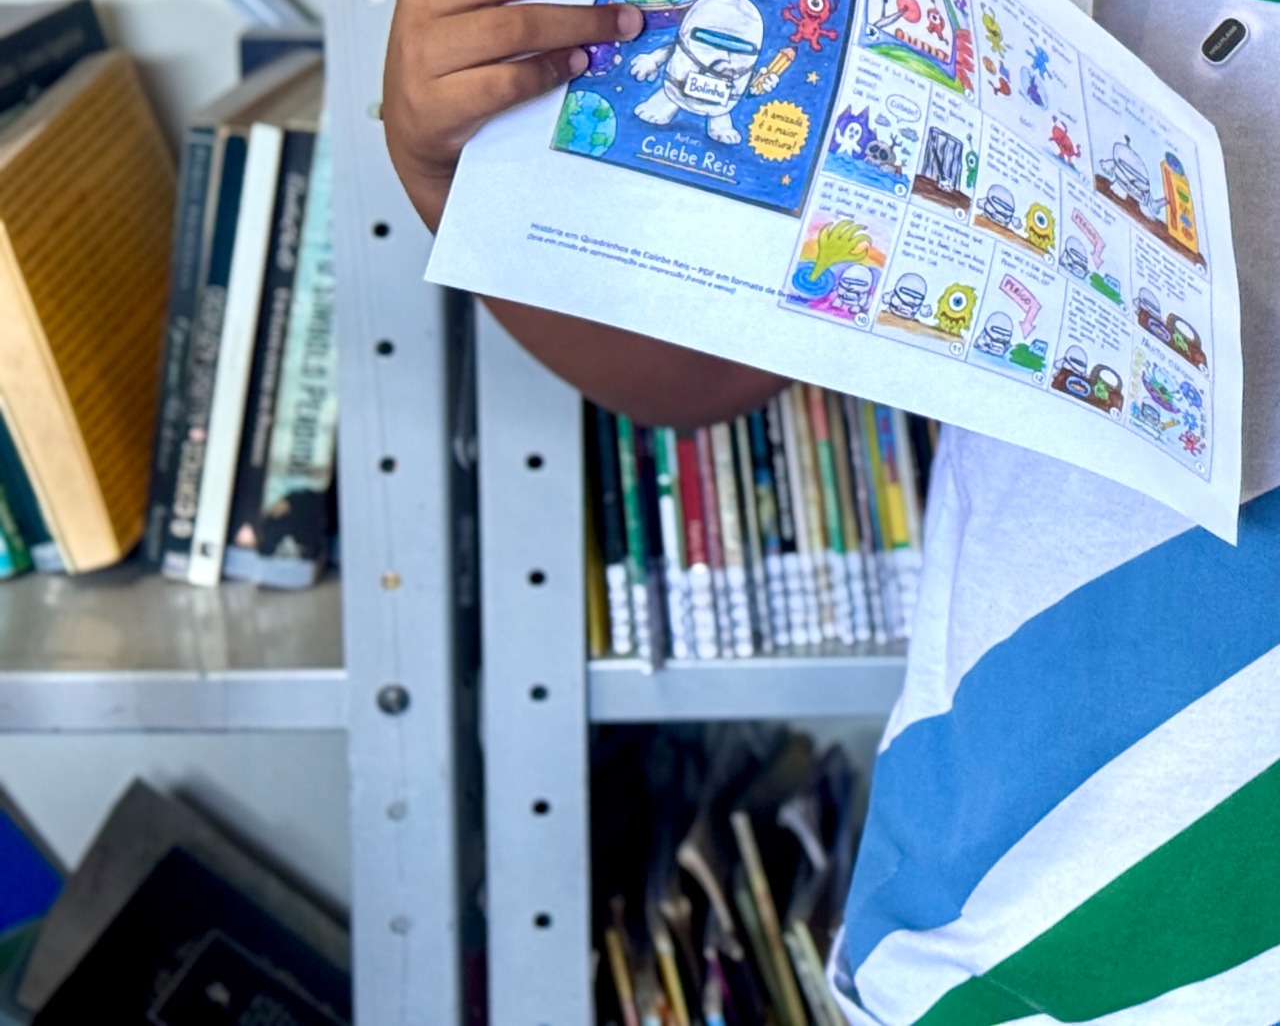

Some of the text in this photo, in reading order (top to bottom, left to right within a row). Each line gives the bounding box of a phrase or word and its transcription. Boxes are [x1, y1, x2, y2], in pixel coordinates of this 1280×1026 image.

[689, 78, 727, 100] Bolinha
[762, 108, 770, 118] A
[641, 135, 737, 177] Calebe Reis
